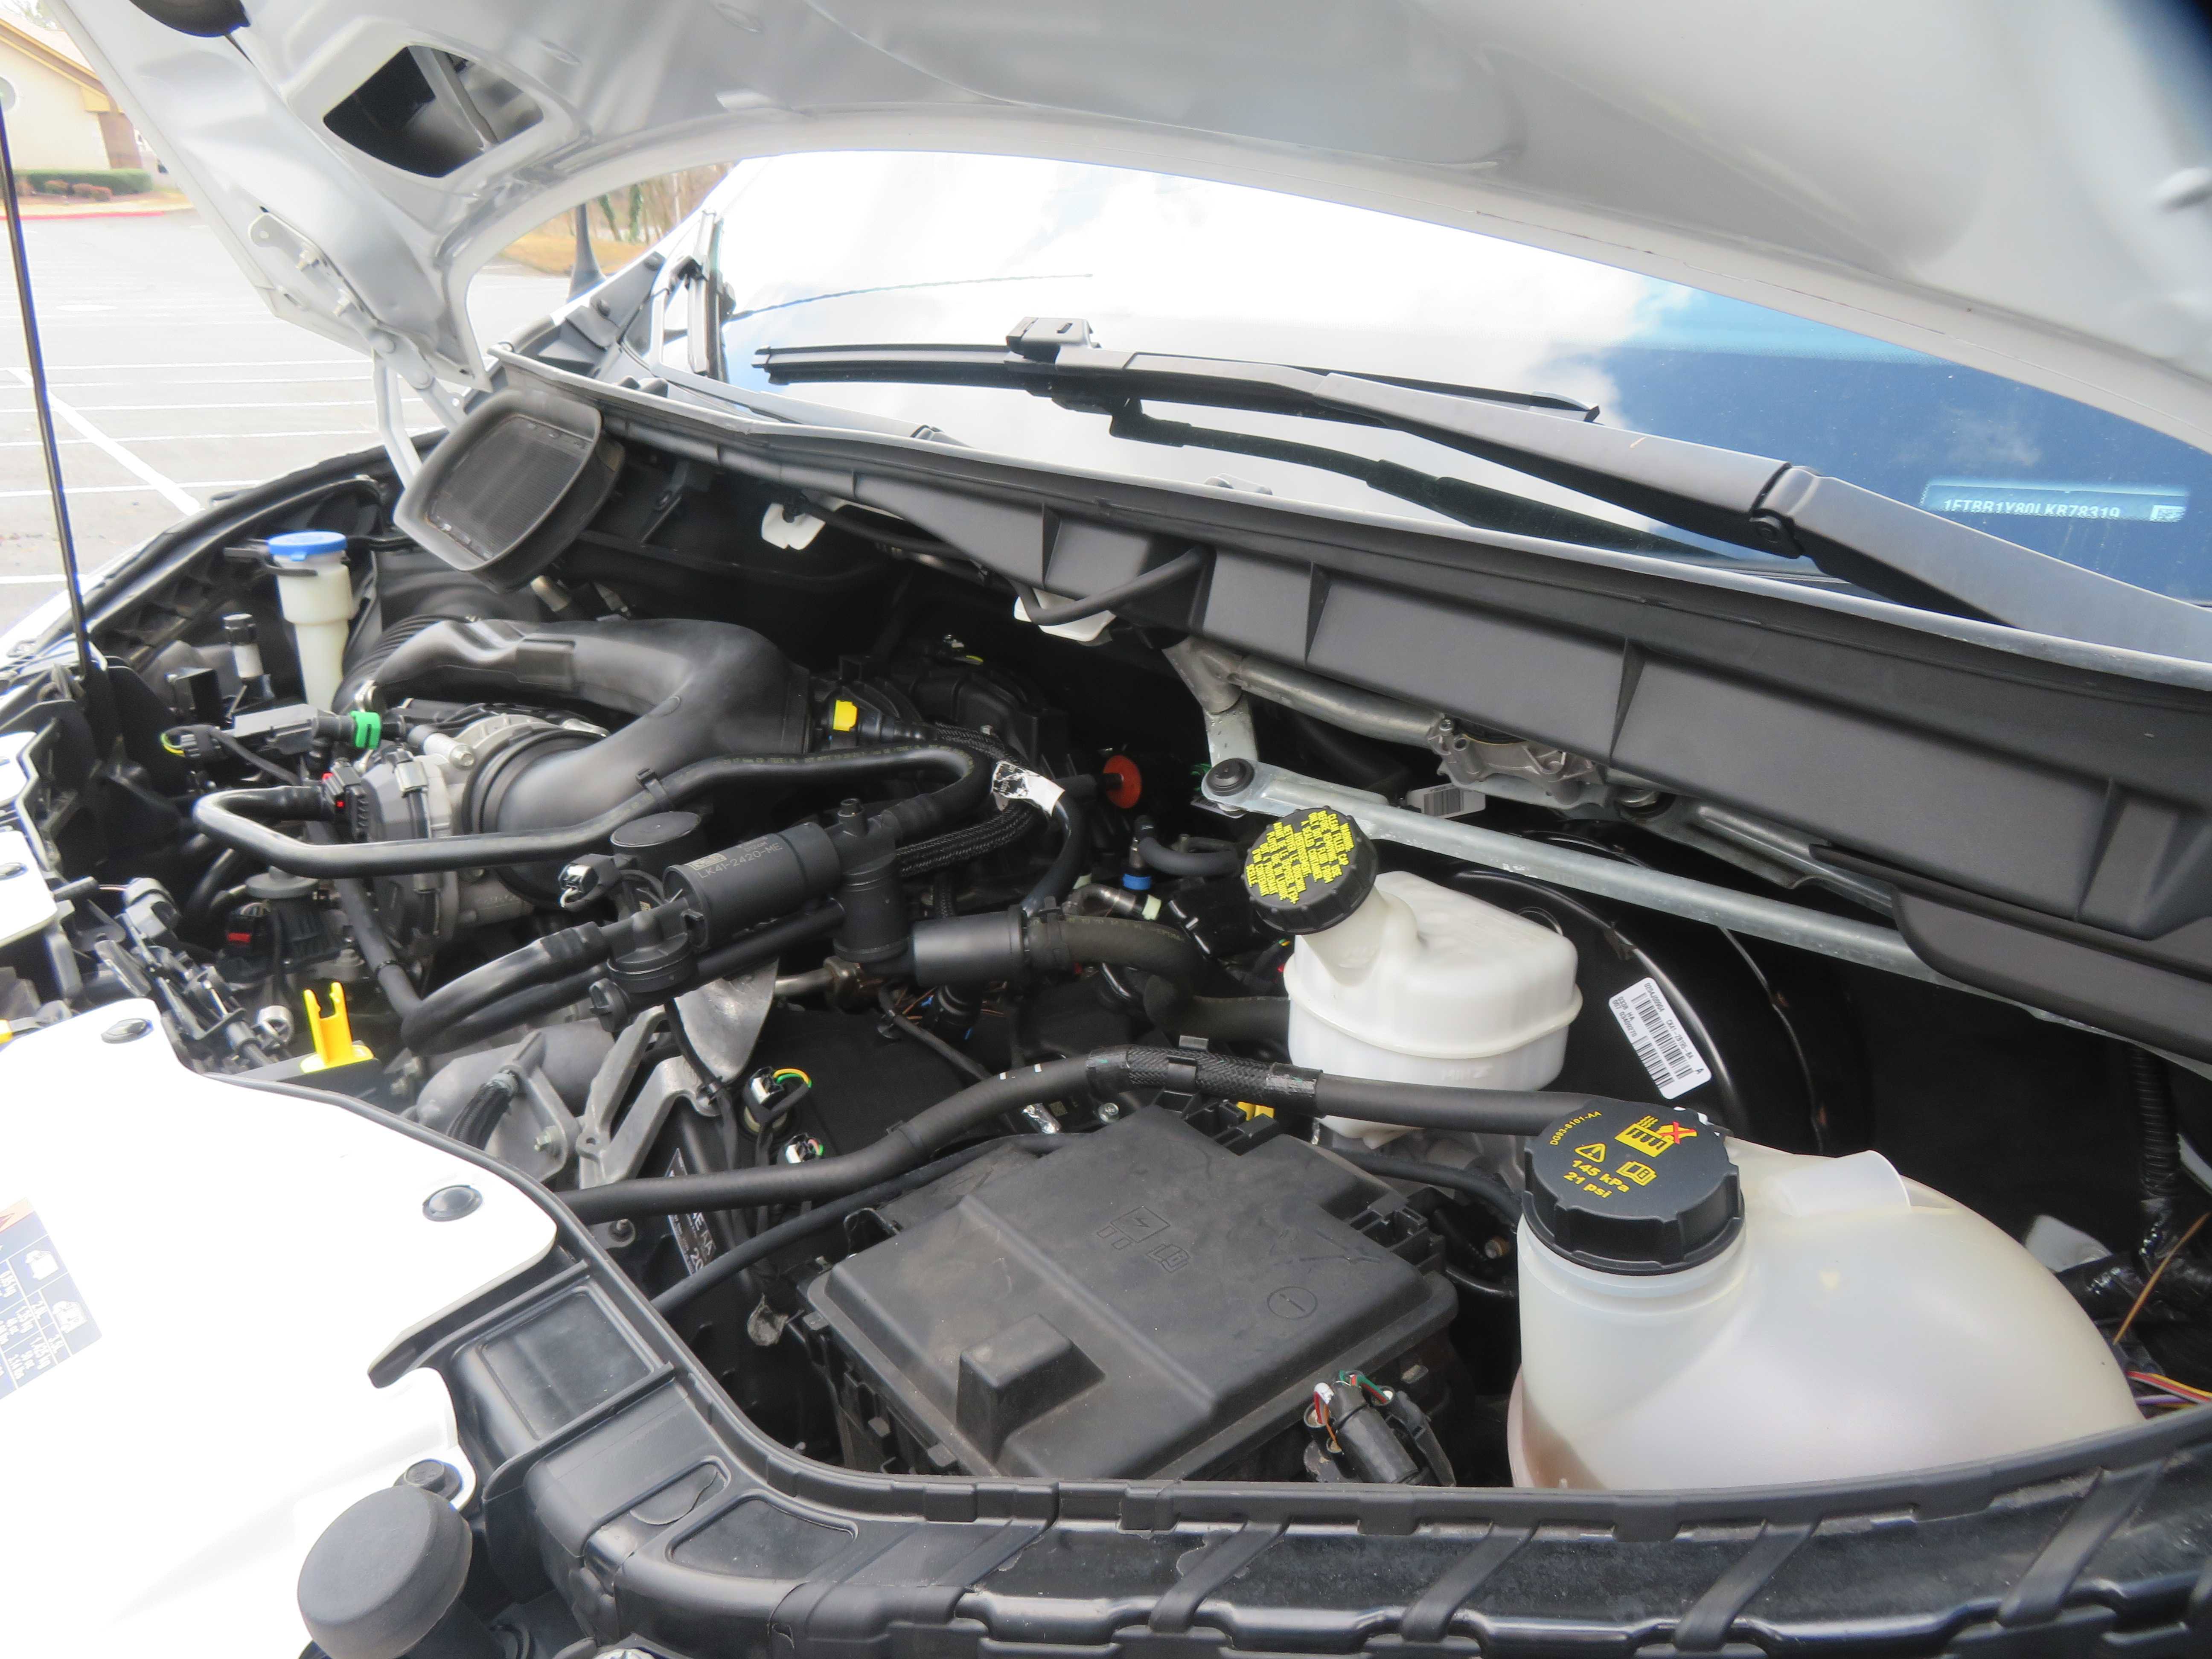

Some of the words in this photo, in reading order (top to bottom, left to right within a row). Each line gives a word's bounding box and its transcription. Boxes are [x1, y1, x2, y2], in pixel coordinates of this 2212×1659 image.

[1308, 812, 1319, 827] ONLY
[1317, 810, 1330, 833] BEFORE
[1327, 814, 1340, 832] CLEAN
[1273, 822, 1285, 839] AVANT
[1302, 826, 1316, 847] SEALED
[1312, 827, 1322, 839] DOT
[1340, 823, 1354, 852] WARNING:
[1260, 842, 1269, 854] DOT
[1267, 831, 1278, 853] PLOYER
[1322, 832, 1337, 863] REMOVING.
[1332, 832, 1345, 853] FILLER
[1271, 853, 1281, 866] QUE
[1282, 824, 1297, 853] NETTOYER
[1292, 864, 1306, 893] BOUCHON
[1293, 832, 1312, 877] AVERTISSEMENT:
[1307, 848, 1324, 881] CONTAINER.
[1317, 846, 1329, 864] FLUID
[1337, 853, 1349, 867] CAP
[1254, 863, 1270, 896] CONTENANT
[1263, 861, 1279, 894] PROVENANT
[1321, 864, 1333, 883] FROM
[1331, 864, 1342, 878] USE
[1563, 1171, 1586, 1185] 21
[1583, 1183, 1612, 1198] psi
[1572, 1160, 1601, 1176] 145
[1599, 1173, 1630, 1193] kPa
